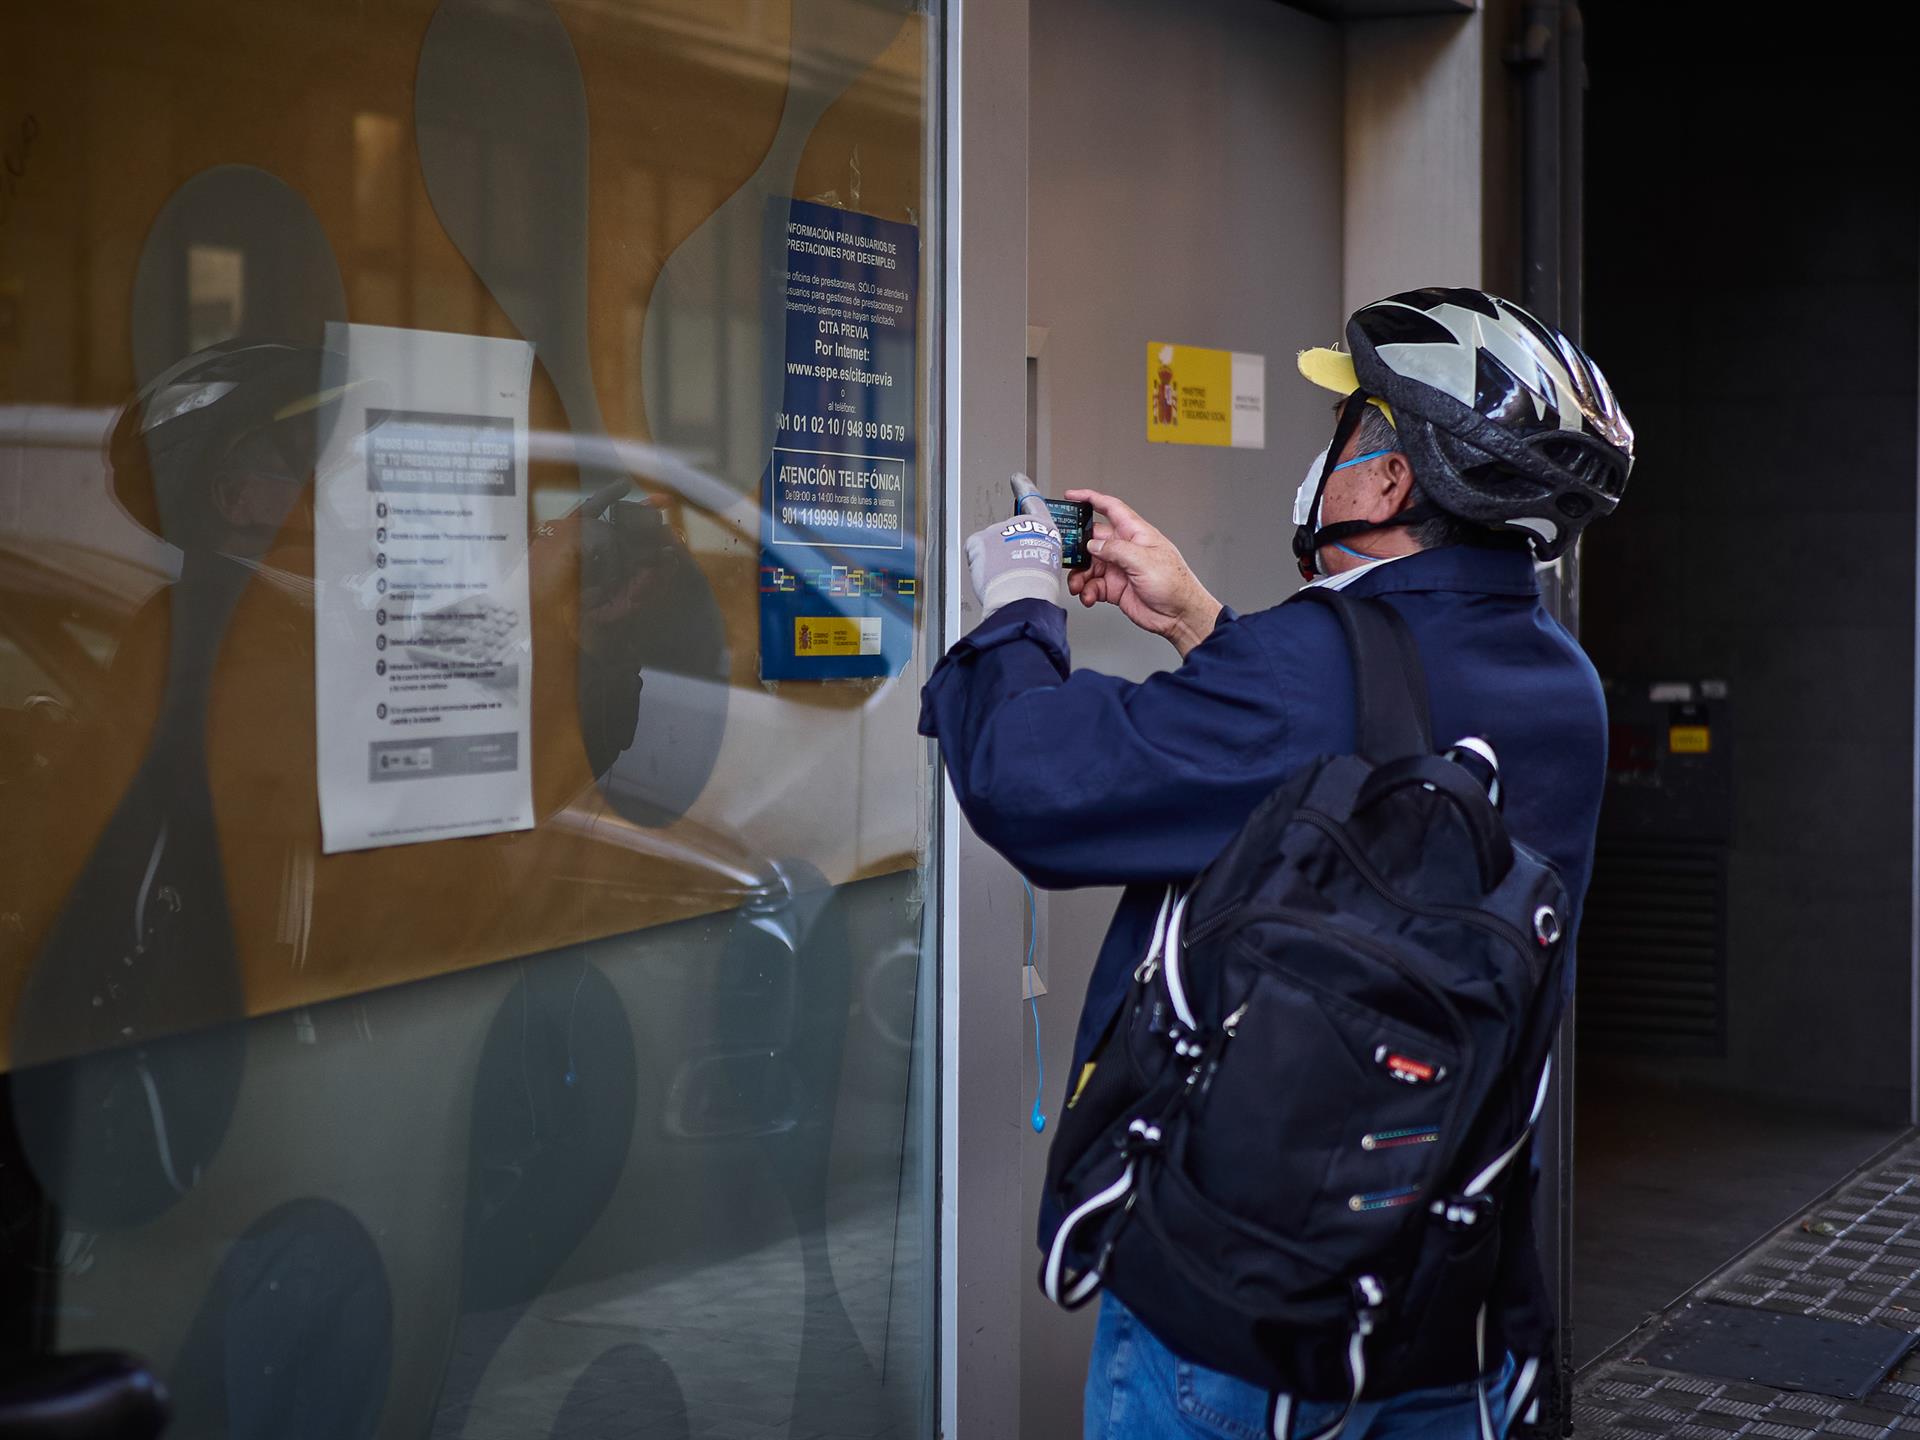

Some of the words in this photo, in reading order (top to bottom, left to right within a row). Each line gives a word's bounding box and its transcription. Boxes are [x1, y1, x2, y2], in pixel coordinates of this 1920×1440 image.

[787, 223, 834, 241] NFORMACIÓN
[837, 232, 854, 245] PARA
[855, 237, 887, 253] USUARIOS
[888, 244, 896, 254] DE
[787, 240, 841, 259] PRESTACIONES
[842, 249, 855, 262] POR
[858, 252, 895, 270] DESEMPLEO
[792, 272, 810, 283] oficina
[812, 274, 819, 285] de
[877, 287, 884, 295] se
[811, 291, 824, 301] para
[826, 292, 852, 305] gestiones
[853, 295, 861, 305] de
[862, 298, 894, 312] prestaciones
[895, 305, 903, 313] por
[818, 306, 841, 318] siempre
[843, 310, 852, 319] que
[853, 312, 869, 322] hayan
[819, 320, 839, 335] CITA
[841, 324, 869, 339] PREVIA
[815, 340, 832, 355] Por
[835, 343, 870, 361] Internet:
[787, 362, 893, 387] www.sepe.es/citaprevia
[840, 389, 845, 398] o
[828, 402, 833, 411] al
[793, 416, 806, 432] 01
[811, 416, 824, 433] 02
[828, 418, 839, 435] 10
[847, 420, 863, 437] 948
[866, 423, 877, 439] 99
[880, 424, 893, 440] 05
[895, 425, 904, 442] 79
[779, 464, 835, 486] ATENCIÓN
[838, 469, 901, 492] TELEFÓNICA
[811, 494, 816, 502] a
[818, 492, 833, 503] 14:00
[834, 494, 849, 504] horas
[850, 494, 857, 504] de
[858, 494, 872, 505] lunes
[873, 498, 878, 506] a
[783, 507, 797, 525] 901
[800, 508, 839, 527] 119999
[847, 511, 863, 528] 948
[867, 512, 897, 530] 990598
